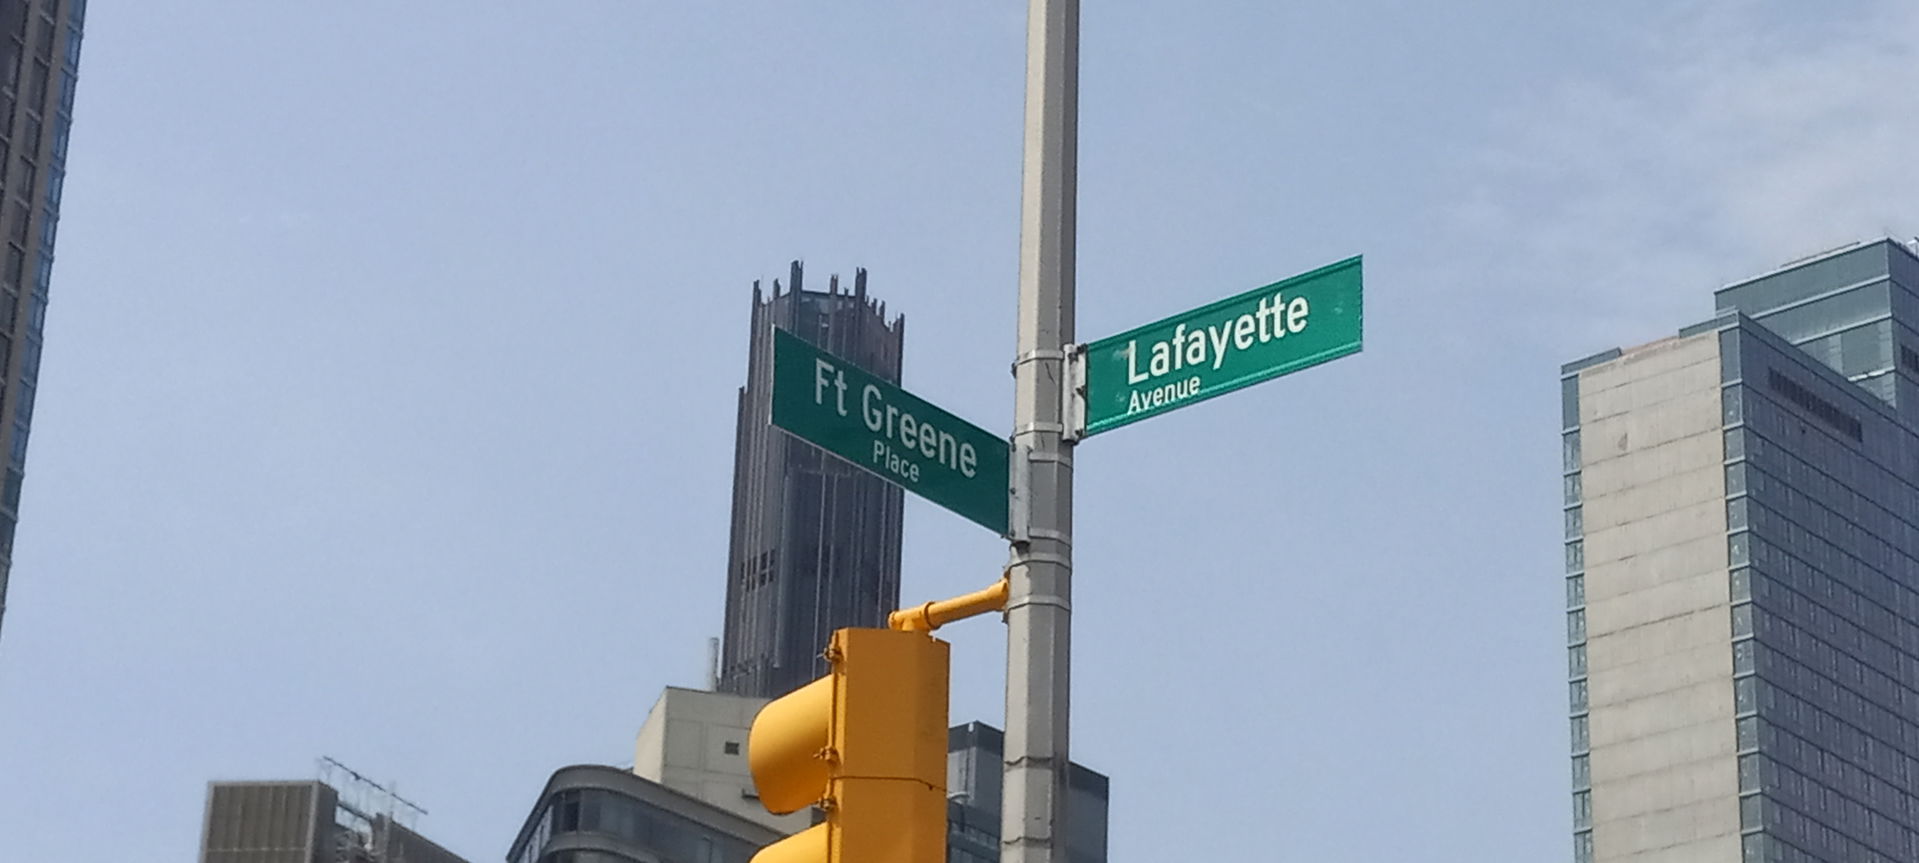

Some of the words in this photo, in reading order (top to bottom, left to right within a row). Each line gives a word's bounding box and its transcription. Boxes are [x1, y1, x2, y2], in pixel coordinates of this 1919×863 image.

[1127, 294, 1308, 384] Lafayette
[815, 358, 848, 417] Ft
[863, 385, 977, 478] Greene
[1127, 375, 1200, 415] Avenue
[873, 441, 920, 482] Place
